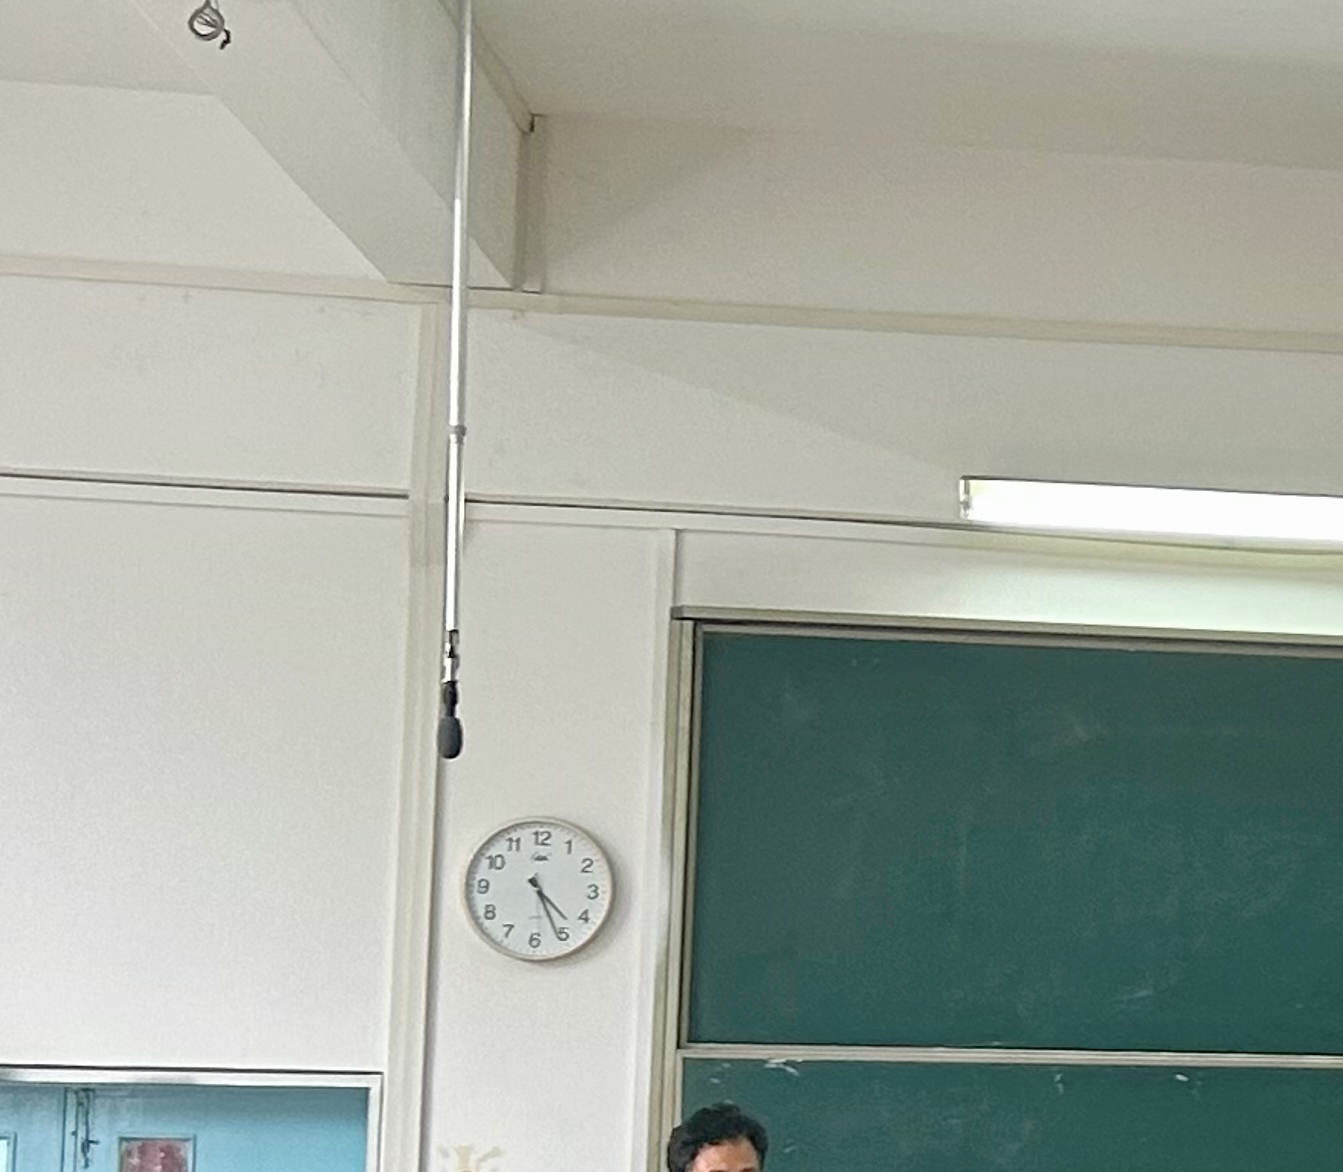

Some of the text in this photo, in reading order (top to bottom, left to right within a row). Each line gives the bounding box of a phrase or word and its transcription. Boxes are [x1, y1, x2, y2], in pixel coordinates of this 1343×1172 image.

[506, 837, 521, 851] 11
[532, 830, 552, 846] 12
[565, 840, 573, 854] 1
[486, 854, 505, 870] 10
[580, 858, 594, 873] 2
[477, 878, 490, 894] 9
[587, 884, 600, 900] 3
[484, 904, 496, 920] 8
[578, 909, 590, 923] 4
[502, 924, 515, 938] 7
[558, 927, 570, 941] 5
[528, 933, 541, 948] 6
